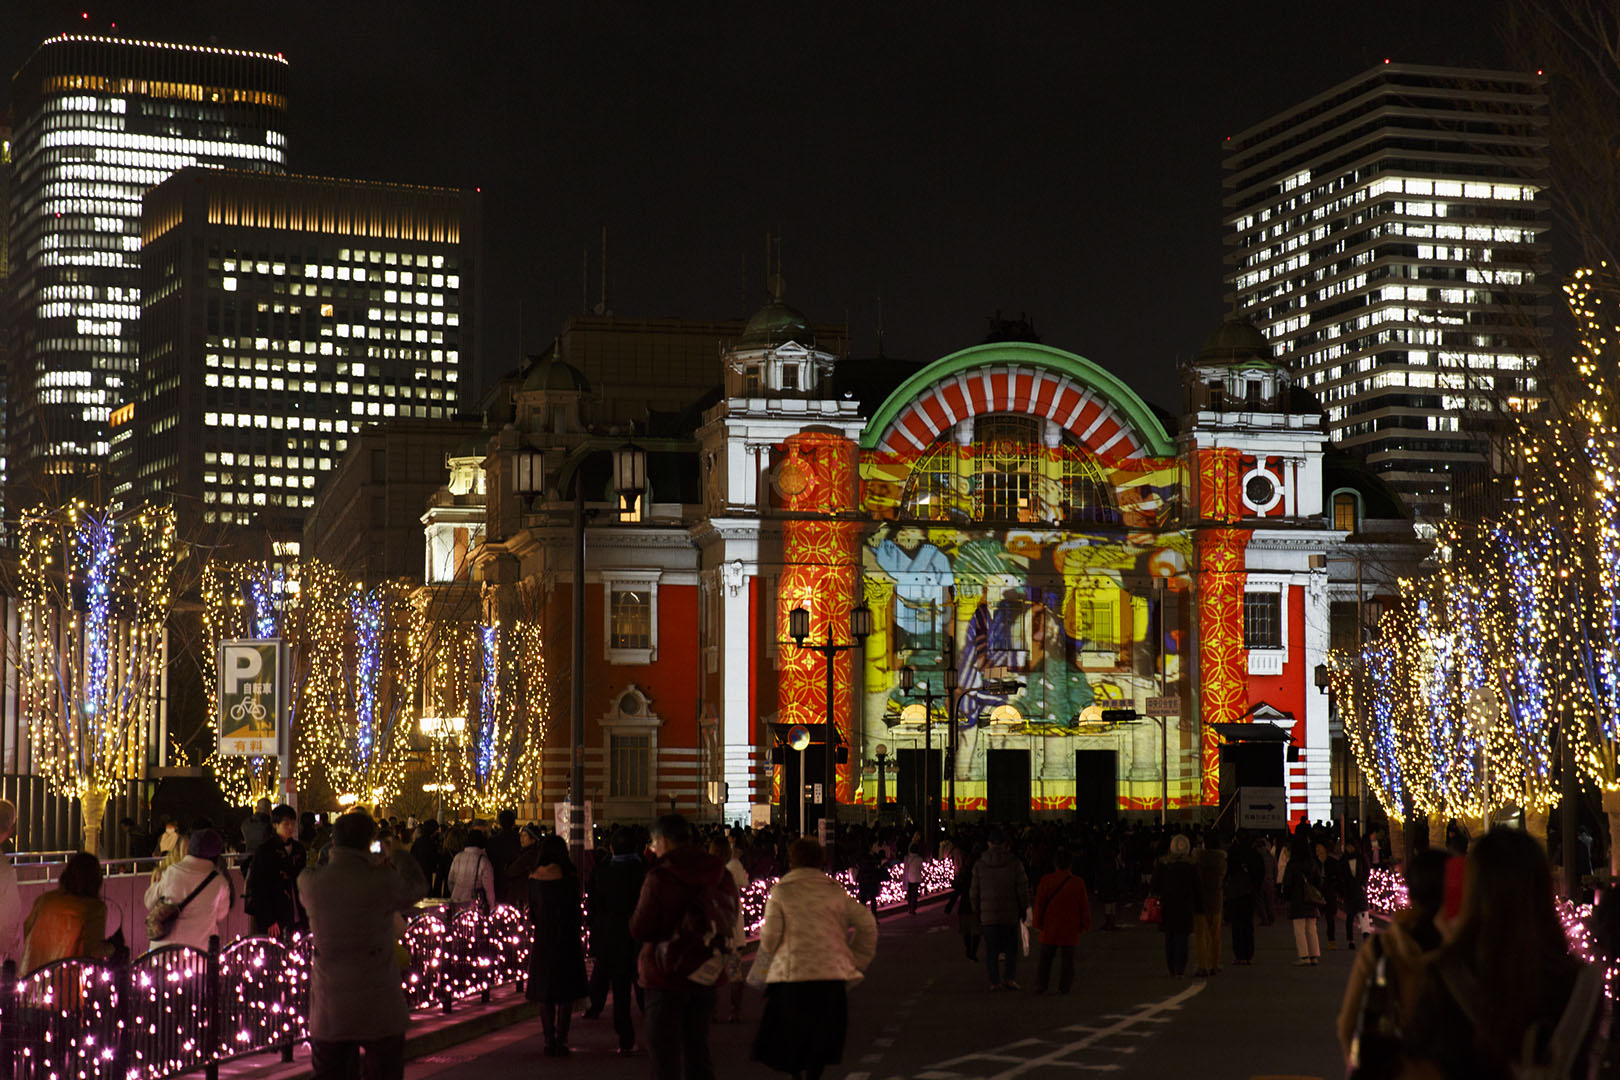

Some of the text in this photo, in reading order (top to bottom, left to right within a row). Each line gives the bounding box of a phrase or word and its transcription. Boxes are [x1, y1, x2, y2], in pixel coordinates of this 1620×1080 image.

[225, 647, 262, 694] P
[243, 682, 272, 695] 自転車
[234, 740, 262, 752] 有料
